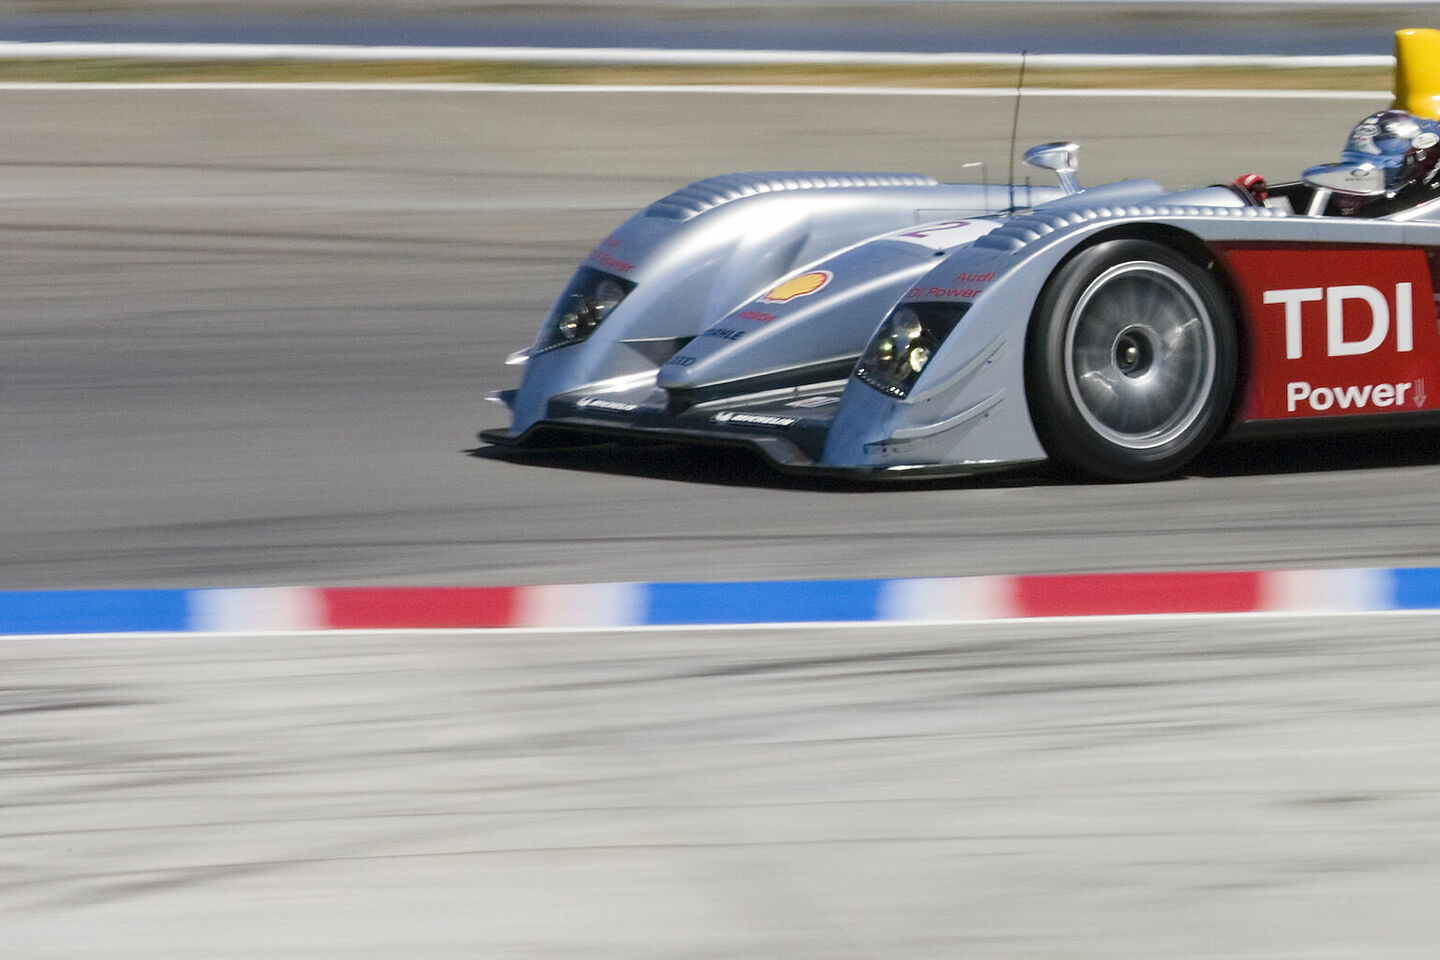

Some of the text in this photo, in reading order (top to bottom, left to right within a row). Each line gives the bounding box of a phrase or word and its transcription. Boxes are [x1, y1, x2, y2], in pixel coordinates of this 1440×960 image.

[956, 272, 995, 282] Audi
[926, 286, 982, 298] Power
[1263, 282, 1413, 360] TDI
[1287, 381, 1412, 412] Power
